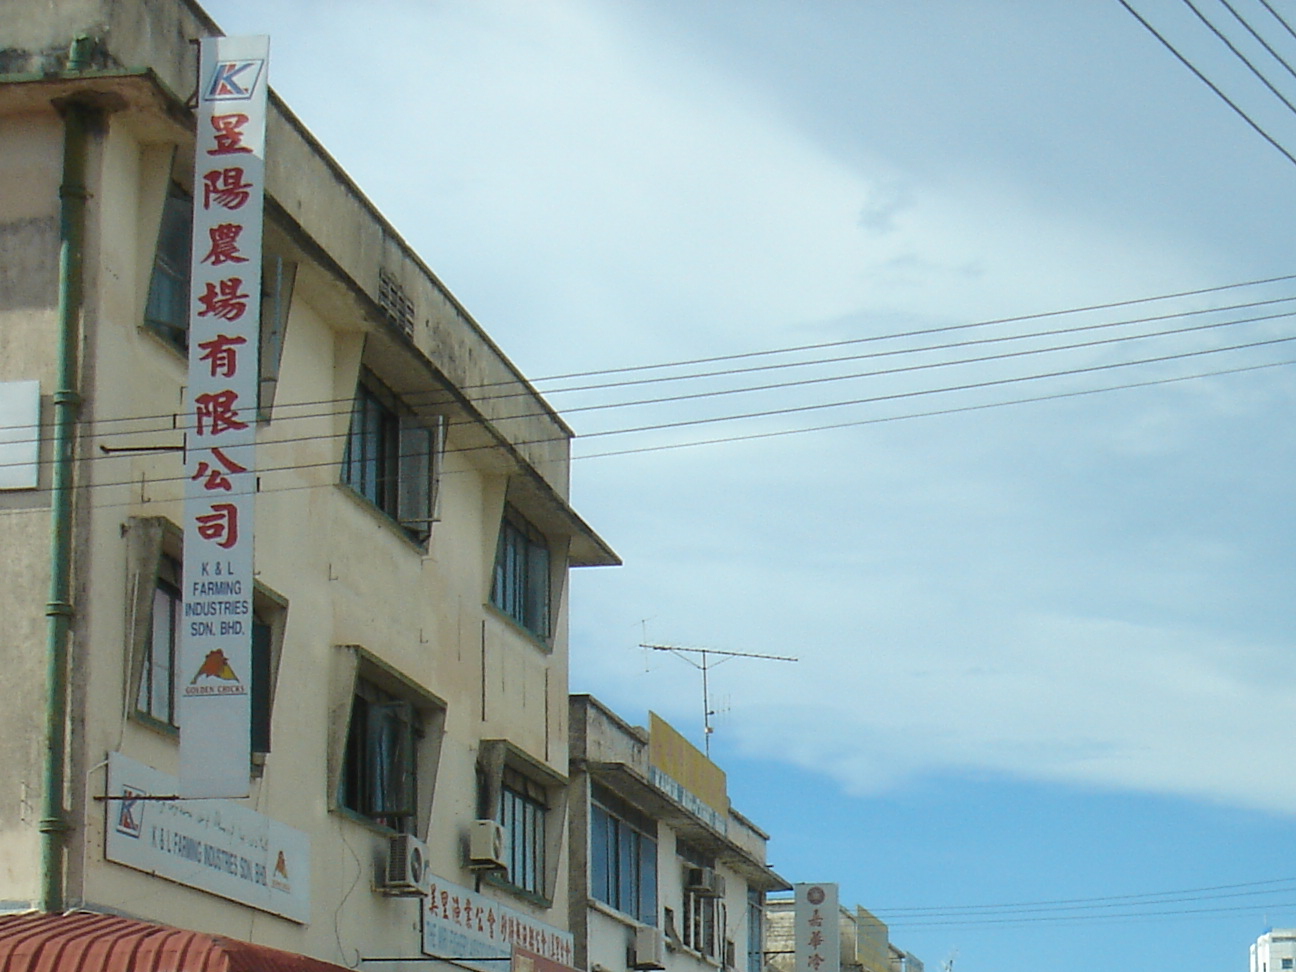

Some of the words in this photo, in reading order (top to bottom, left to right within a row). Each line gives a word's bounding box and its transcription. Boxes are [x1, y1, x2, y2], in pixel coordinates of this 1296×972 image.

[201, 562, 210, 577] K
[214, 561, 222, 576] &
[227, 561, 235, 576] L
[192, 581, 242, 597] FARMING
[184, 600, 249, 617] INDUSTRIES
[190, 621, 216, 637] SDN.
[220, 620, 246, 636] BHD.
